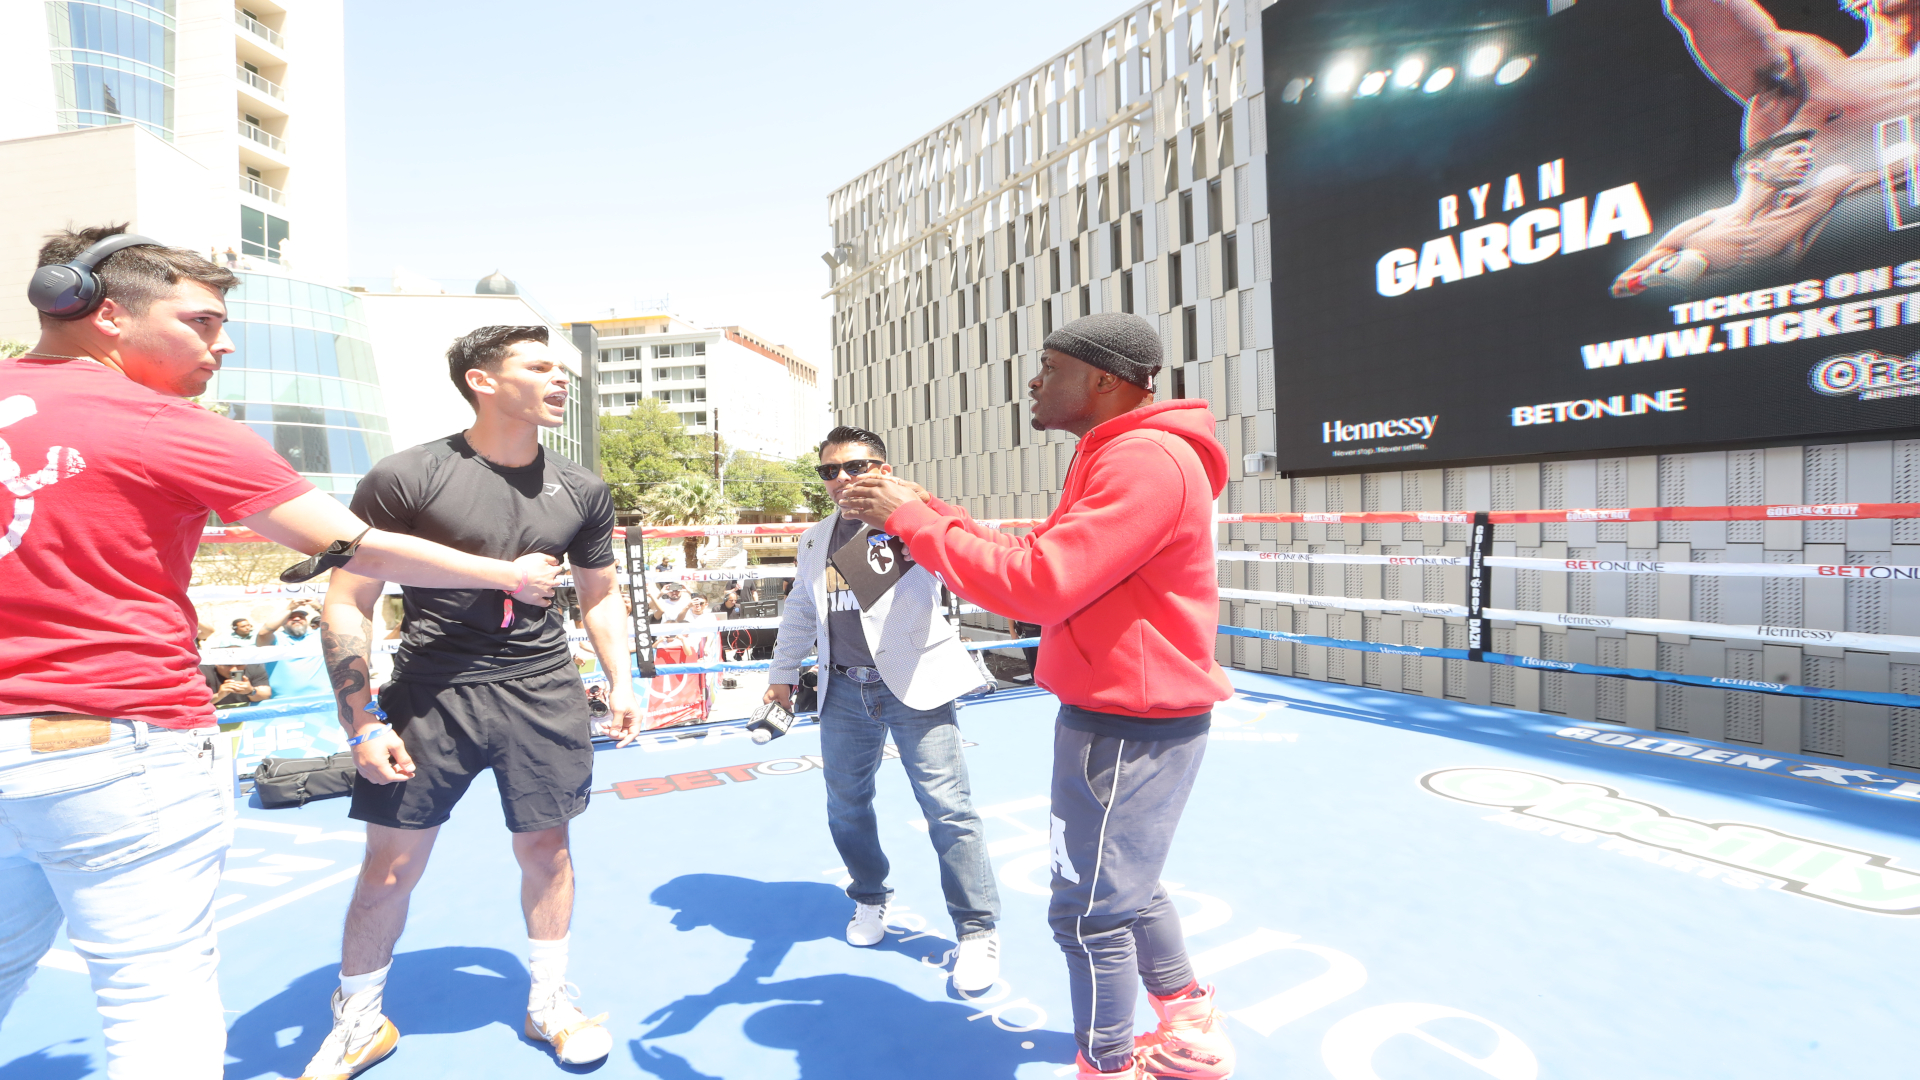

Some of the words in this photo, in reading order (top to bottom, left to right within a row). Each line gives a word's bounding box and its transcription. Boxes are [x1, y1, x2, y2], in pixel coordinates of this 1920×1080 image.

[1439, 158, 1564, 230] RYAN
[1375, 182, 1653, 297] GARCIA
[1669, 279, 1824, 325] TICKETS
[1824, 266, 1893, 299] ON
[1510, 388, 1687, 426] BETONLINE
[1322, 415, 1439, 443] Hennessy
[1332, 449, 1356, 457] Never
[1377, 446, 1402, 454] Never
[1831, 506, 1858, 516] BOY
[1389, 557, 1461, 565] BETONLINE
[1473, 525, 1484, 577] GOLDEN
[1566, 560, 1666, 572] BETONLINE
[630, 545, 649, 662] HENNESSY
[1472, 588, 1480, 615] BOY
[1469, 619, 1481, 649] DAZN
[1557, 614, 1614, 627] Hennessy
[1757, 626, 1836, 641] Hennessy
[1522, 656, 1577, 670] Hennessy
[1555, 726, 1783, 771] GOLDEN
